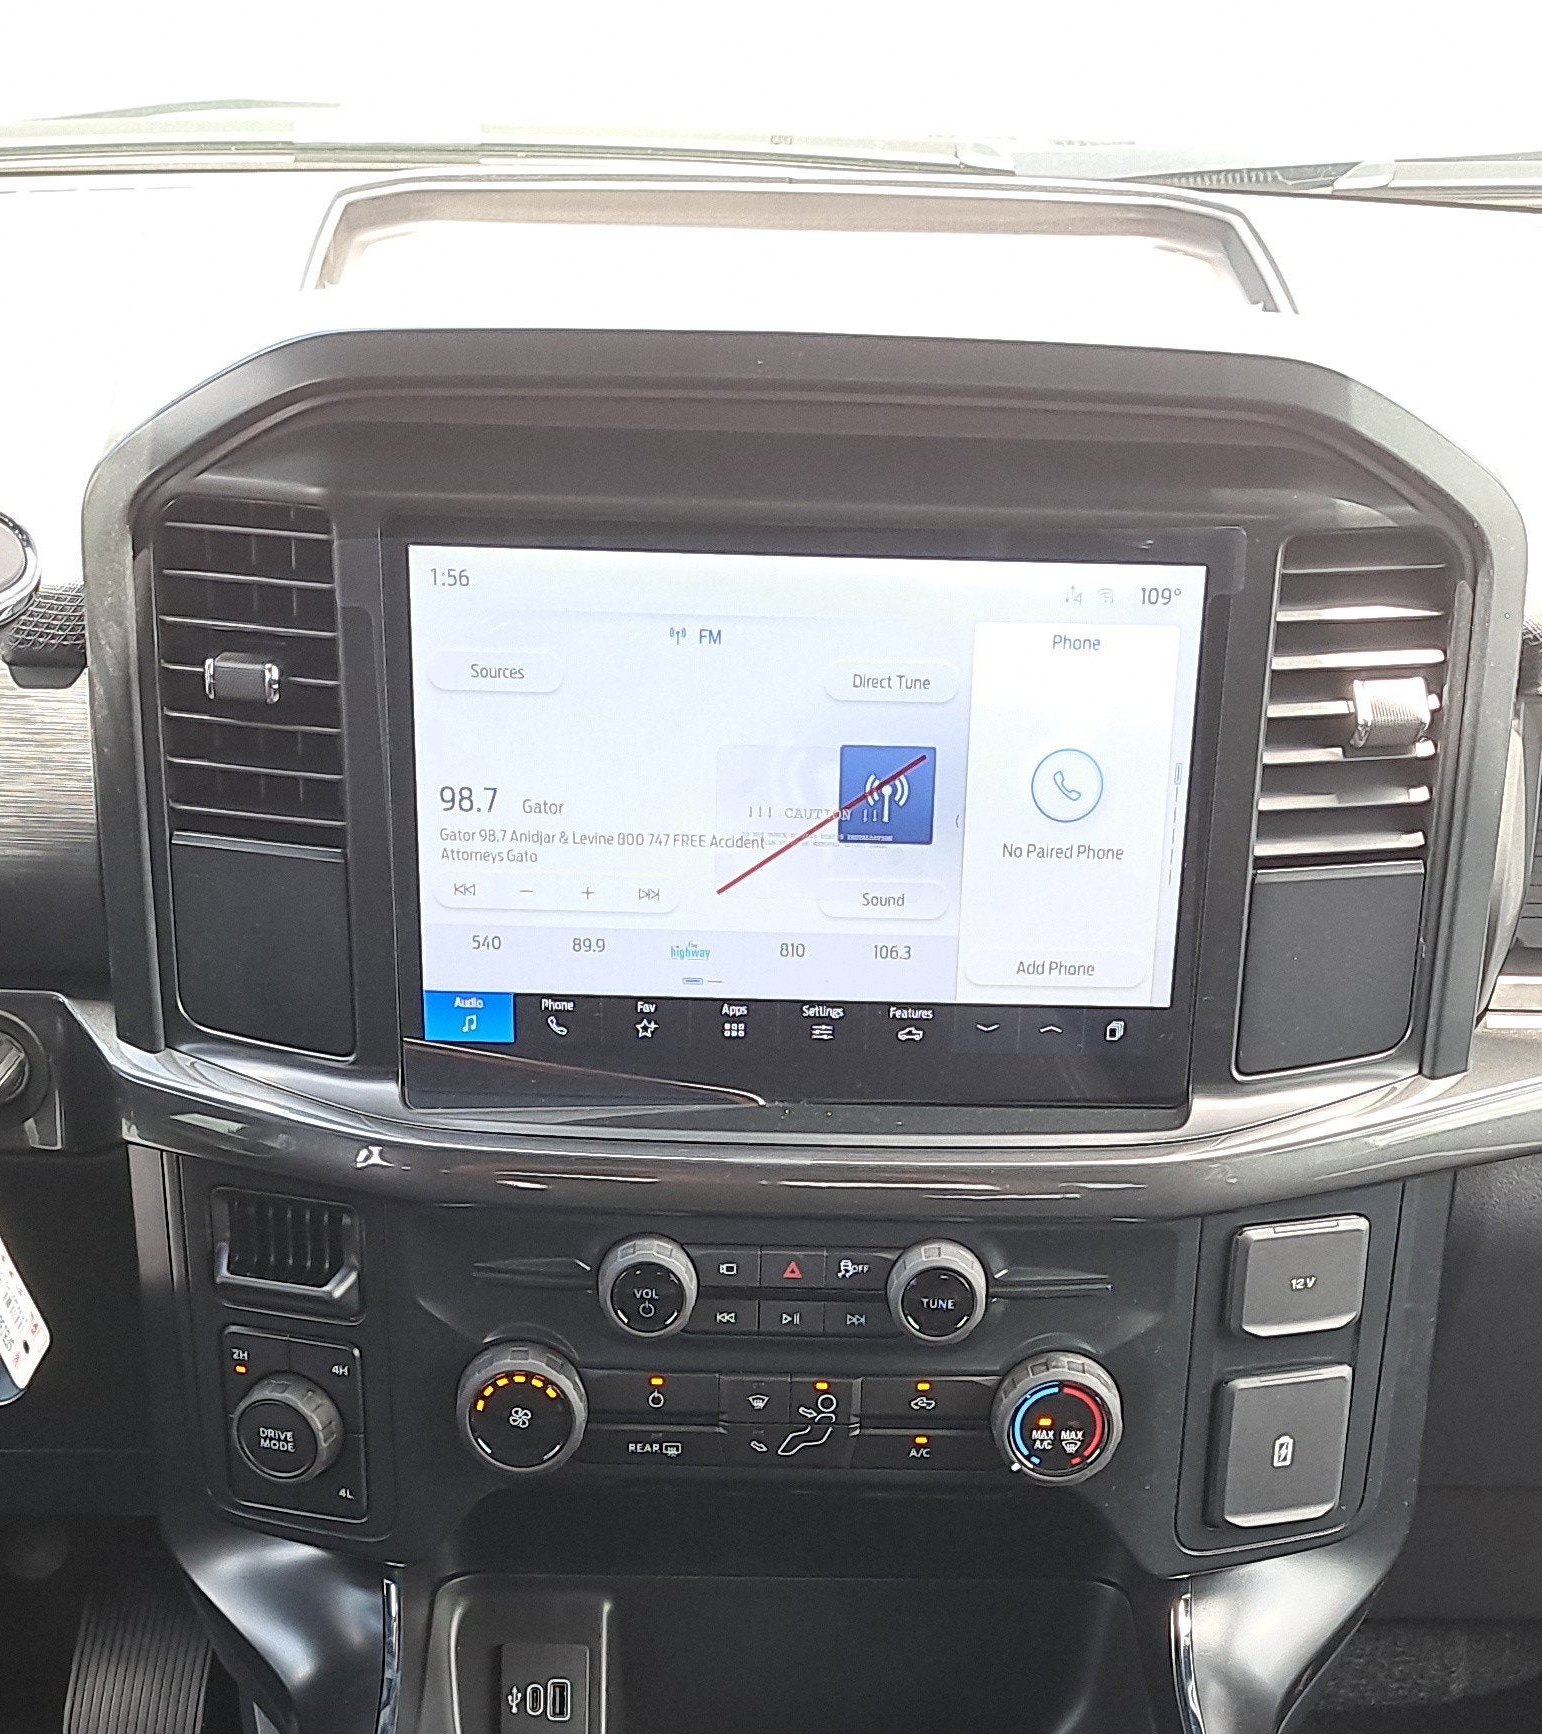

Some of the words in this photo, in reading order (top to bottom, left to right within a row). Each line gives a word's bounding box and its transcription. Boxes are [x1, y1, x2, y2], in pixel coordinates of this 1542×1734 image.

[429, 567, 470, 588] 1:56
[698, 628, 722, 646] FM
[1052, 634, 1101, 652] Phone
[470, 662, 525, 680] Sources
[852, 673, 892, 690] Direct
[896, 674, 931, 691] Tune
[438, 785, 498, 813] 98.7
[521, 798, 564, 815] Gator
[439, 827, 477, 842] Gator
[478, 828, 507, 844] 98.7
[558, 830, 570, 845] &
[572, 830, 615, 846] Levine
[648, 832, 671, 847] 747
[672, 833, 707, 848] FREE
[709, 833, 766, 850] Accident
[441, 846, 505, 865] Attorneys
[506, 848, 539, 864] Gato
[1002, 842, 1023, 859] No
[1026, 842, 1073, 861] Paired
[1076, 843, 1125, 862] Phone
[861, 891, 906, 908] Sound
[471, 934, 502, 951] 540
[572, 937, 606, 954] 89.9
[779, 942, 806, 959] 810
[670, 944, 711, 961] highway
[873, 944, 912, 961] 106.3
[1015, 959, 1047, 976] Add
[1049, 959, 1096, 977] Phone
[454, 997, 485, 1009] Audio
[541, 998, 575, 1012] Phone
[637, 1000, 657, 1013] Fav
[721, 1003, 748, 1017] Apps
[801, 1004, 845, 1019] Settings
[889, 1006, 934, 1020] Features
[851, 1264, 870, 1274] OFF
[1290, 1275, 1317, 1291] 12V
[633, 1287, 660, 1300] VOL
[921, 1296, 956, 1311] TUNE
[331, 1365, 349, 1377] 4H
[259, 1426, 293, 1442] DRIVE
[1032, 1429, 1055, 1440] MAX
[1061, 1429, 1085, 1441] MAX
[259, 1437, 296, 1453] MODE
[628, 1443, 660, 1454] REAR
[908, 1446, 931, 1459] A/C
[1033, 1440, 1053, 1450] A/C
[338, 1487, 355, 1500] 4L
